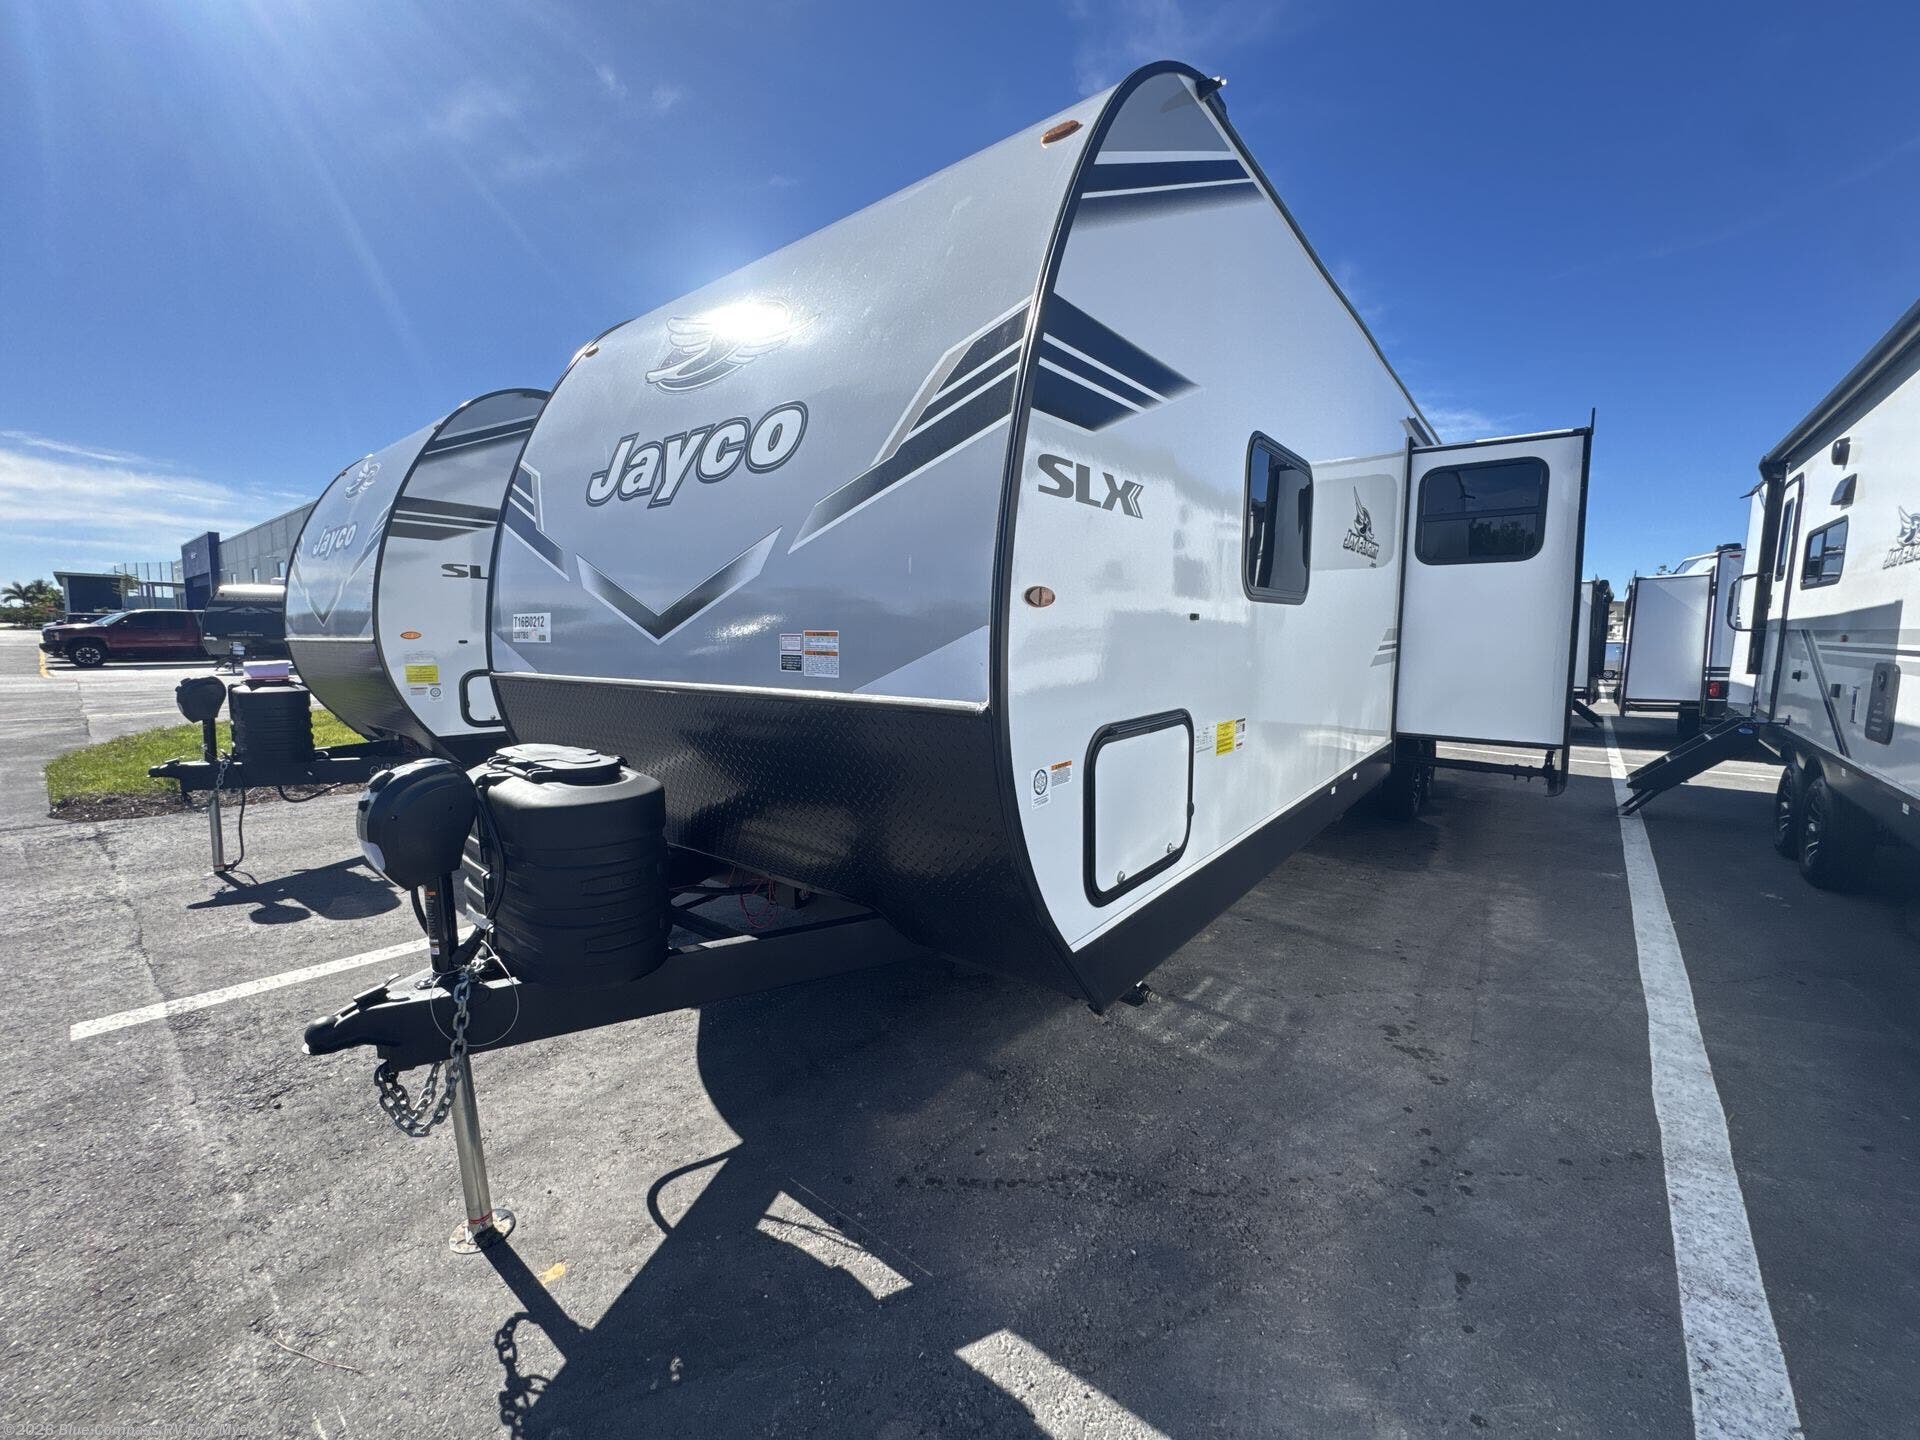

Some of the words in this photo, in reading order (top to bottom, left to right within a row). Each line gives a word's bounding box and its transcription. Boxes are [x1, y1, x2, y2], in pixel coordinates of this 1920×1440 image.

[586, 401, 809, 510] Jayco
[1037, 453, 1145, 520] SLX
[311, 522, 358, 560] Jayco
